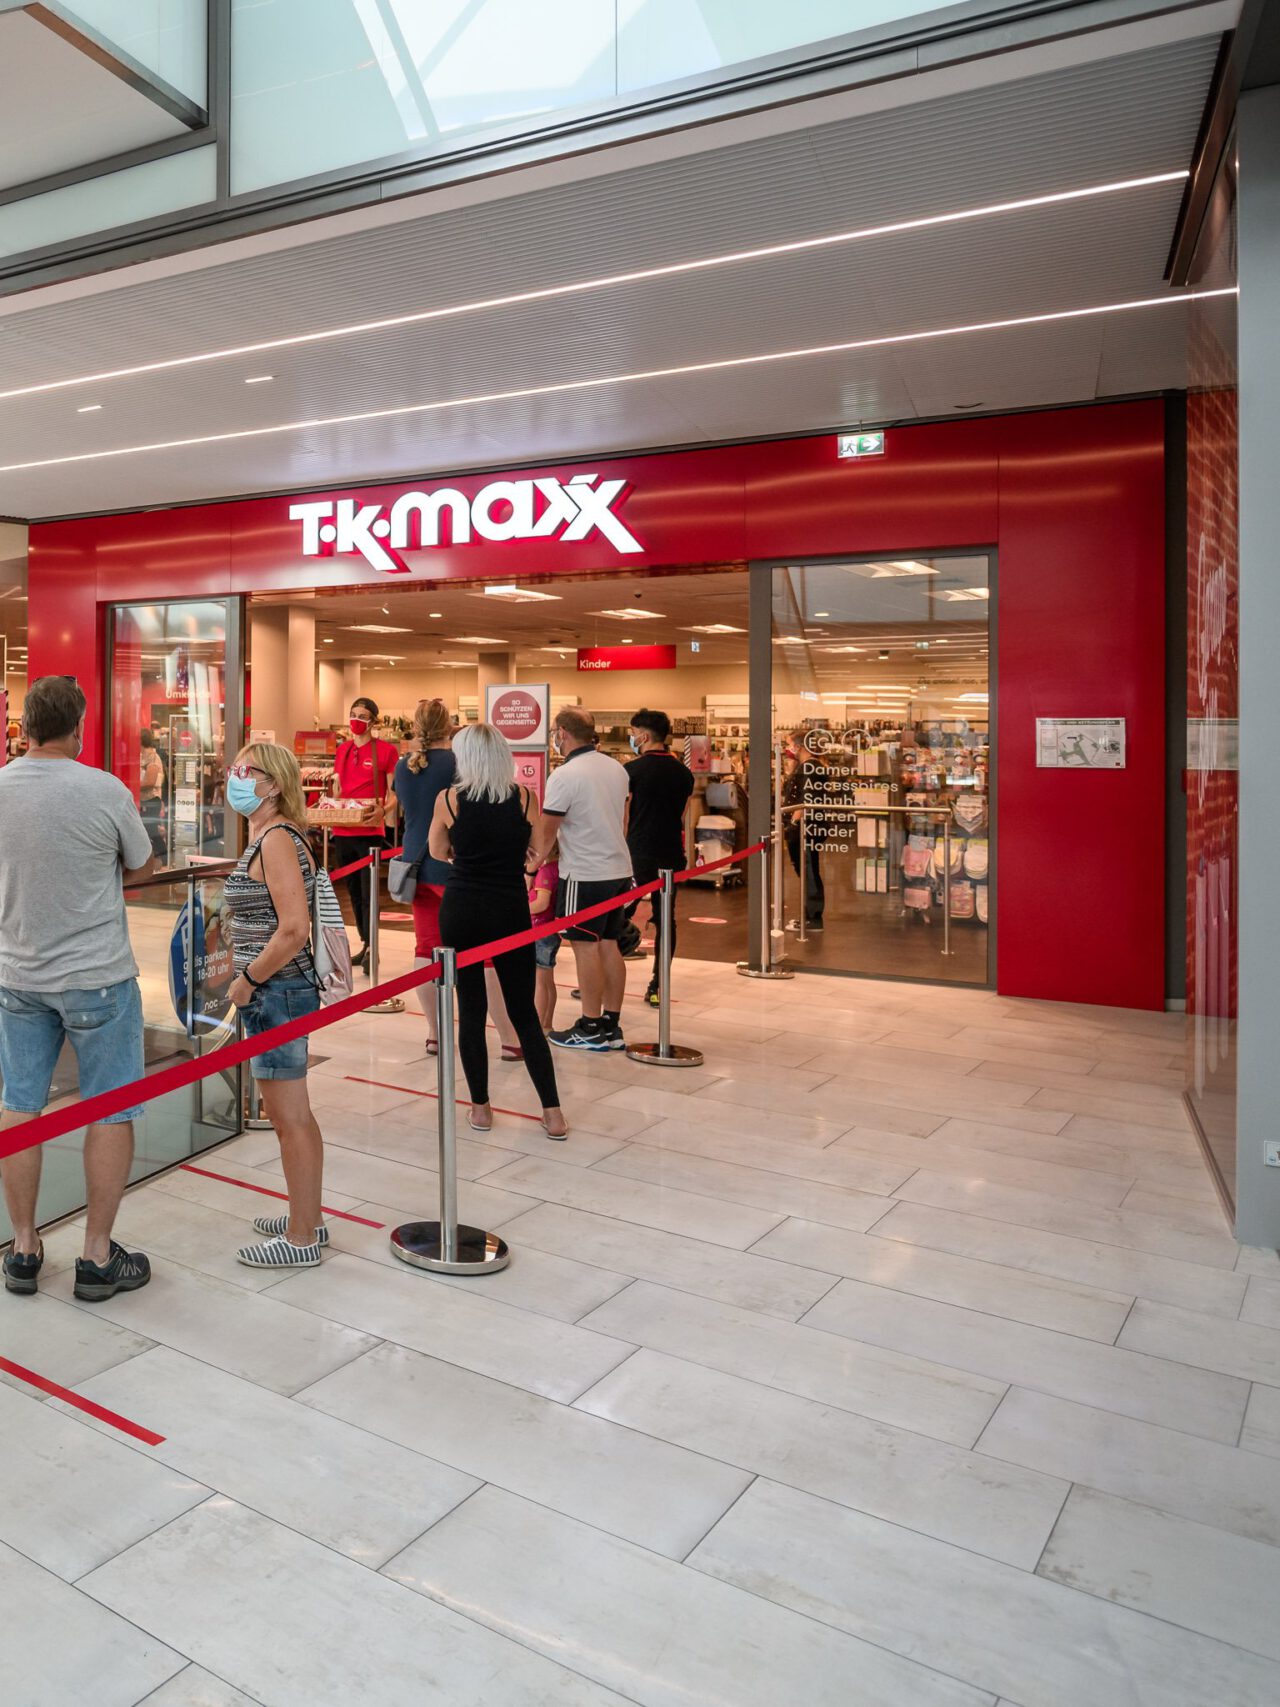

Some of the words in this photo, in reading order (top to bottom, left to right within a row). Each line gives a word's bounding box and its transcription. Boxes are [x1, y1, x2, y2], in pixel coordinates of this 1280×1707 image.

[579, 659, 611, 669] Kinder
[803, 778, 898, 792] Accessoires
[803, 809, 857, 822] Herren
[803, 824, 855, 838] Kinder
[803, 839, 849, 853] Home
[204, 950, 228, 967] parken
[198, 966, 216, 981] 18-20
[217, 962, 230, 975] uhr
